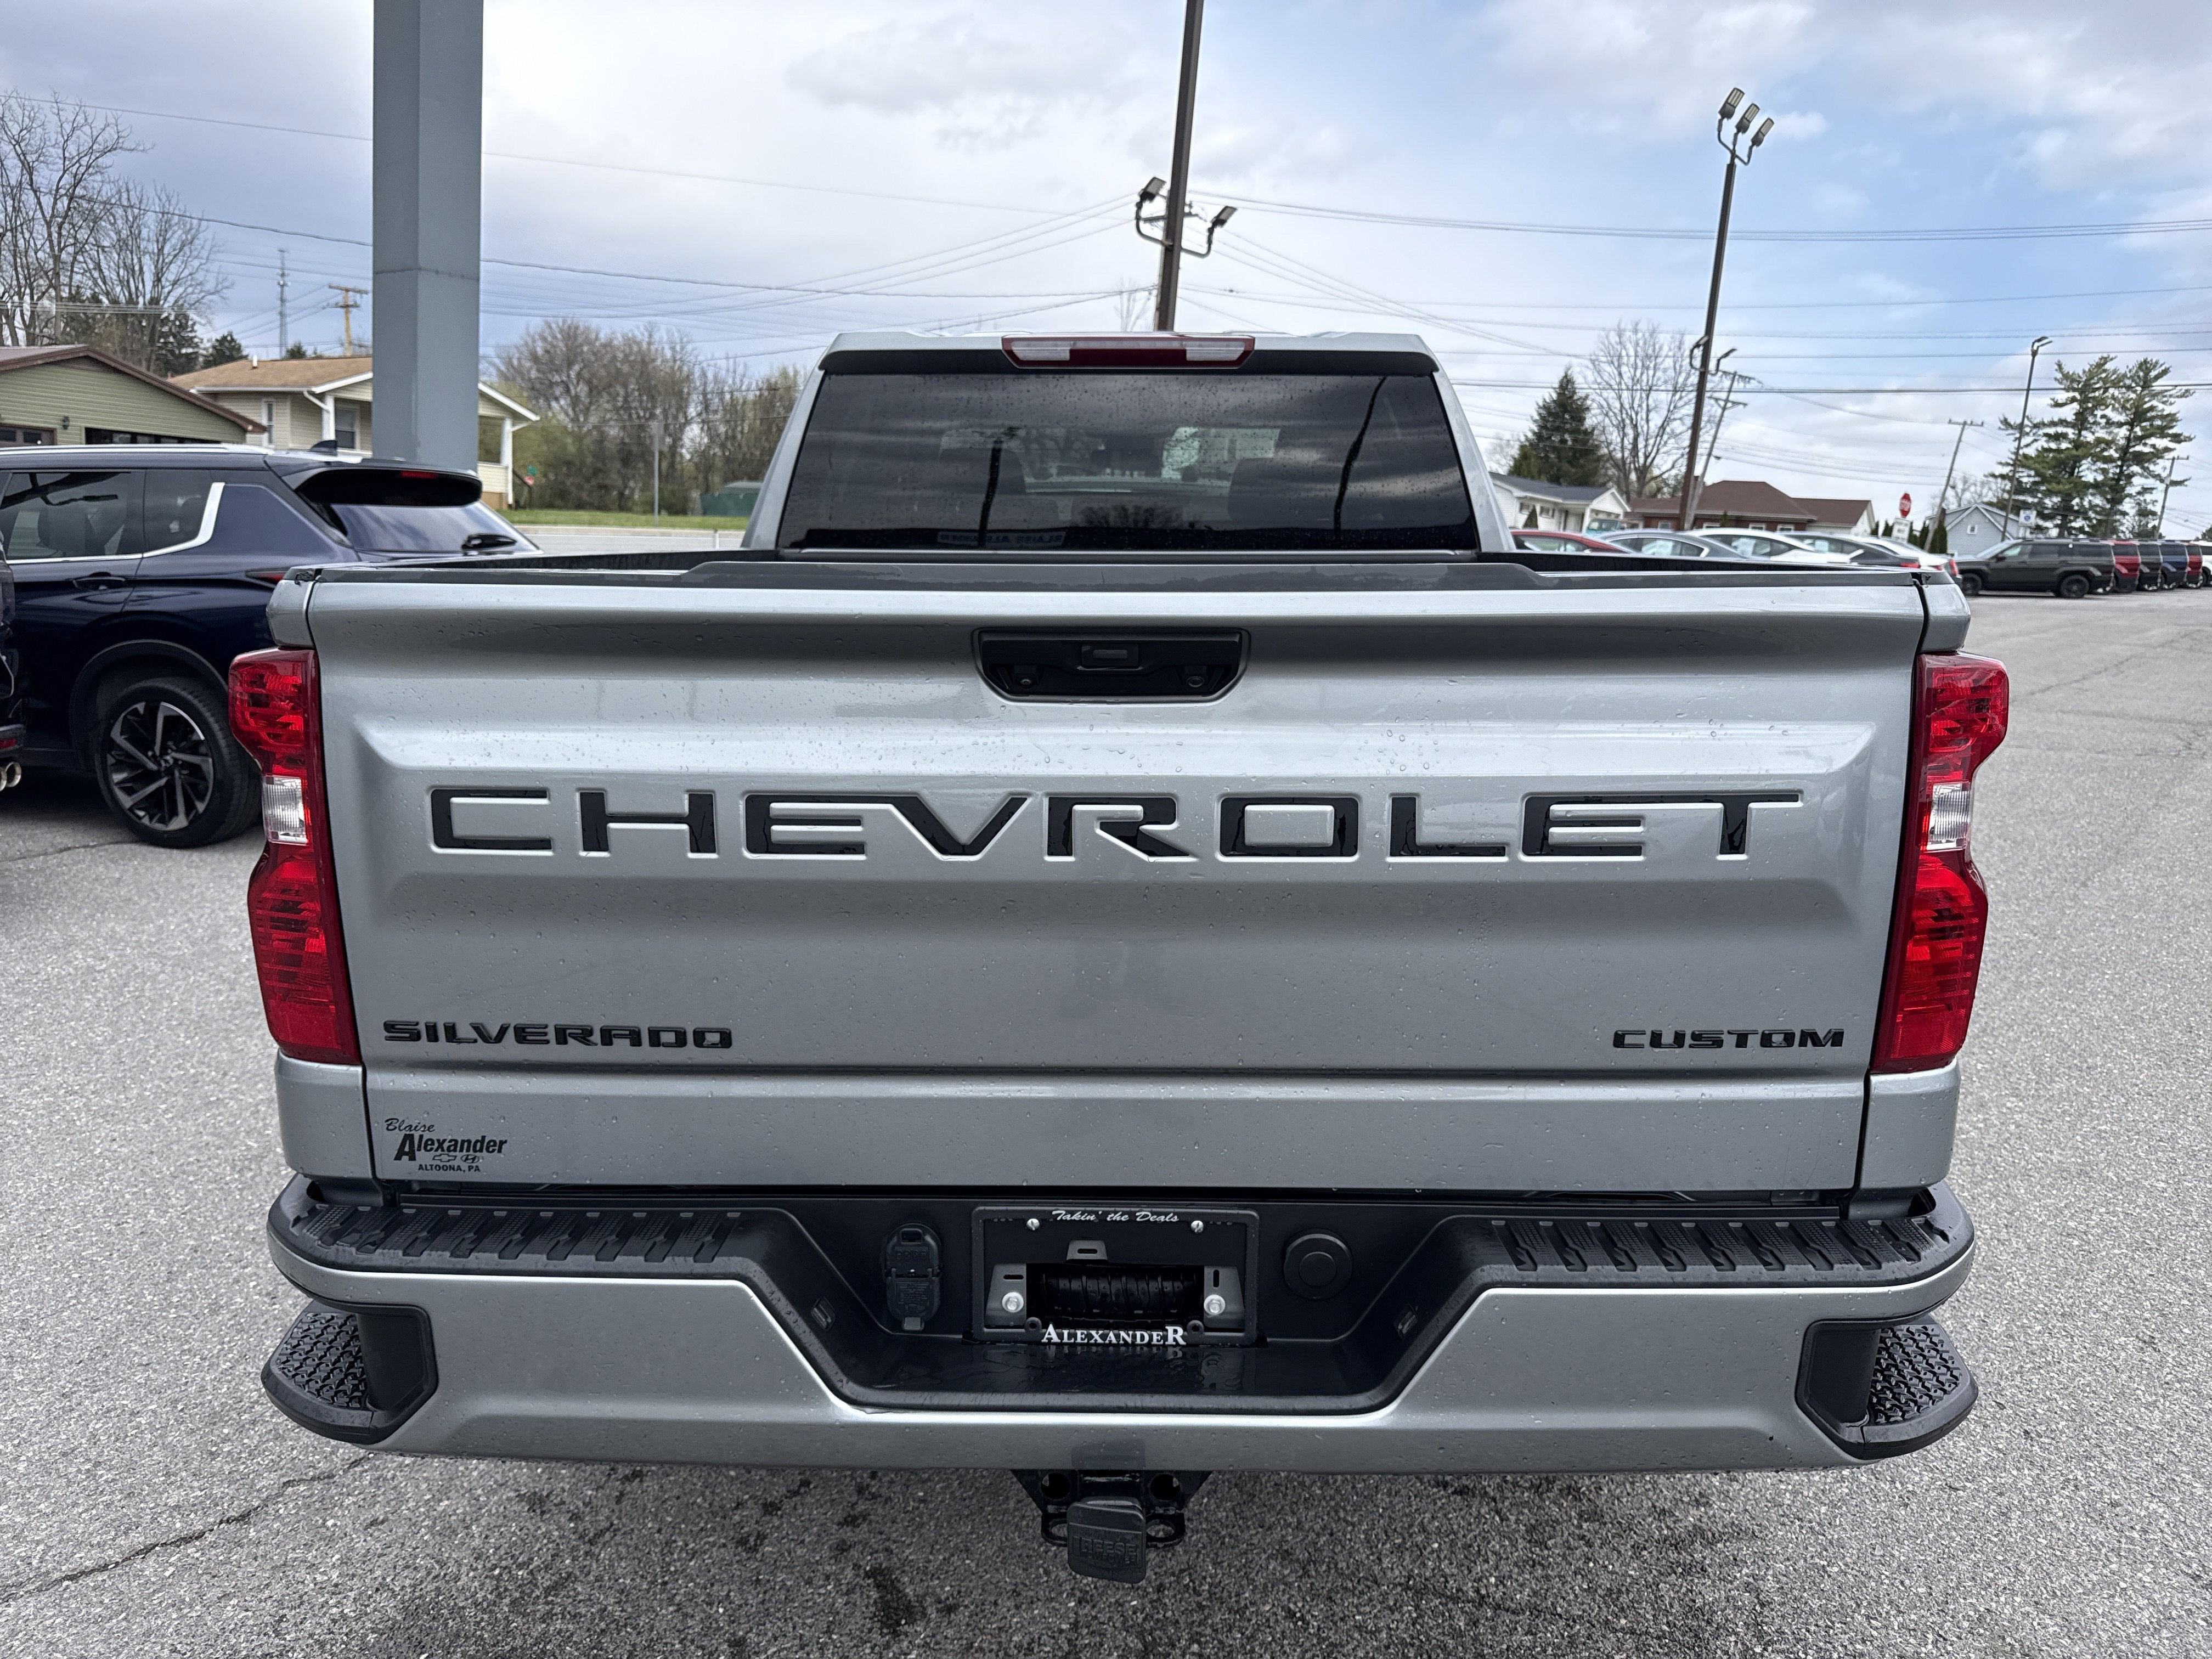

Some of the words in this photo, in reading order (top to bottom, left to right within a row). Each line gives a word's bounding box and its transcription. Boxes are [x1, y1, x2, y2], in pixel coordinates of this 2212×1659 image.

[429, 788, 1803, 859] CHEVROLET
[383, 1020, 732, 1049] SILVERADO
[1613, 1029, 1844, 1048] CUSTOM
[385, 1118, 435, 1132] Blaise
[393, 1133, 507, 1161] Alexander
[417, 1164, 466, 1173] ALTOONA,
[1052, 1210, 1102, 1221] Takin'
[1107, 1211, 1129, 1221] the
[1135, 1211, 1180, 1222] Deals
[1041, 1323, 1187, 1345] ALEXANDER
